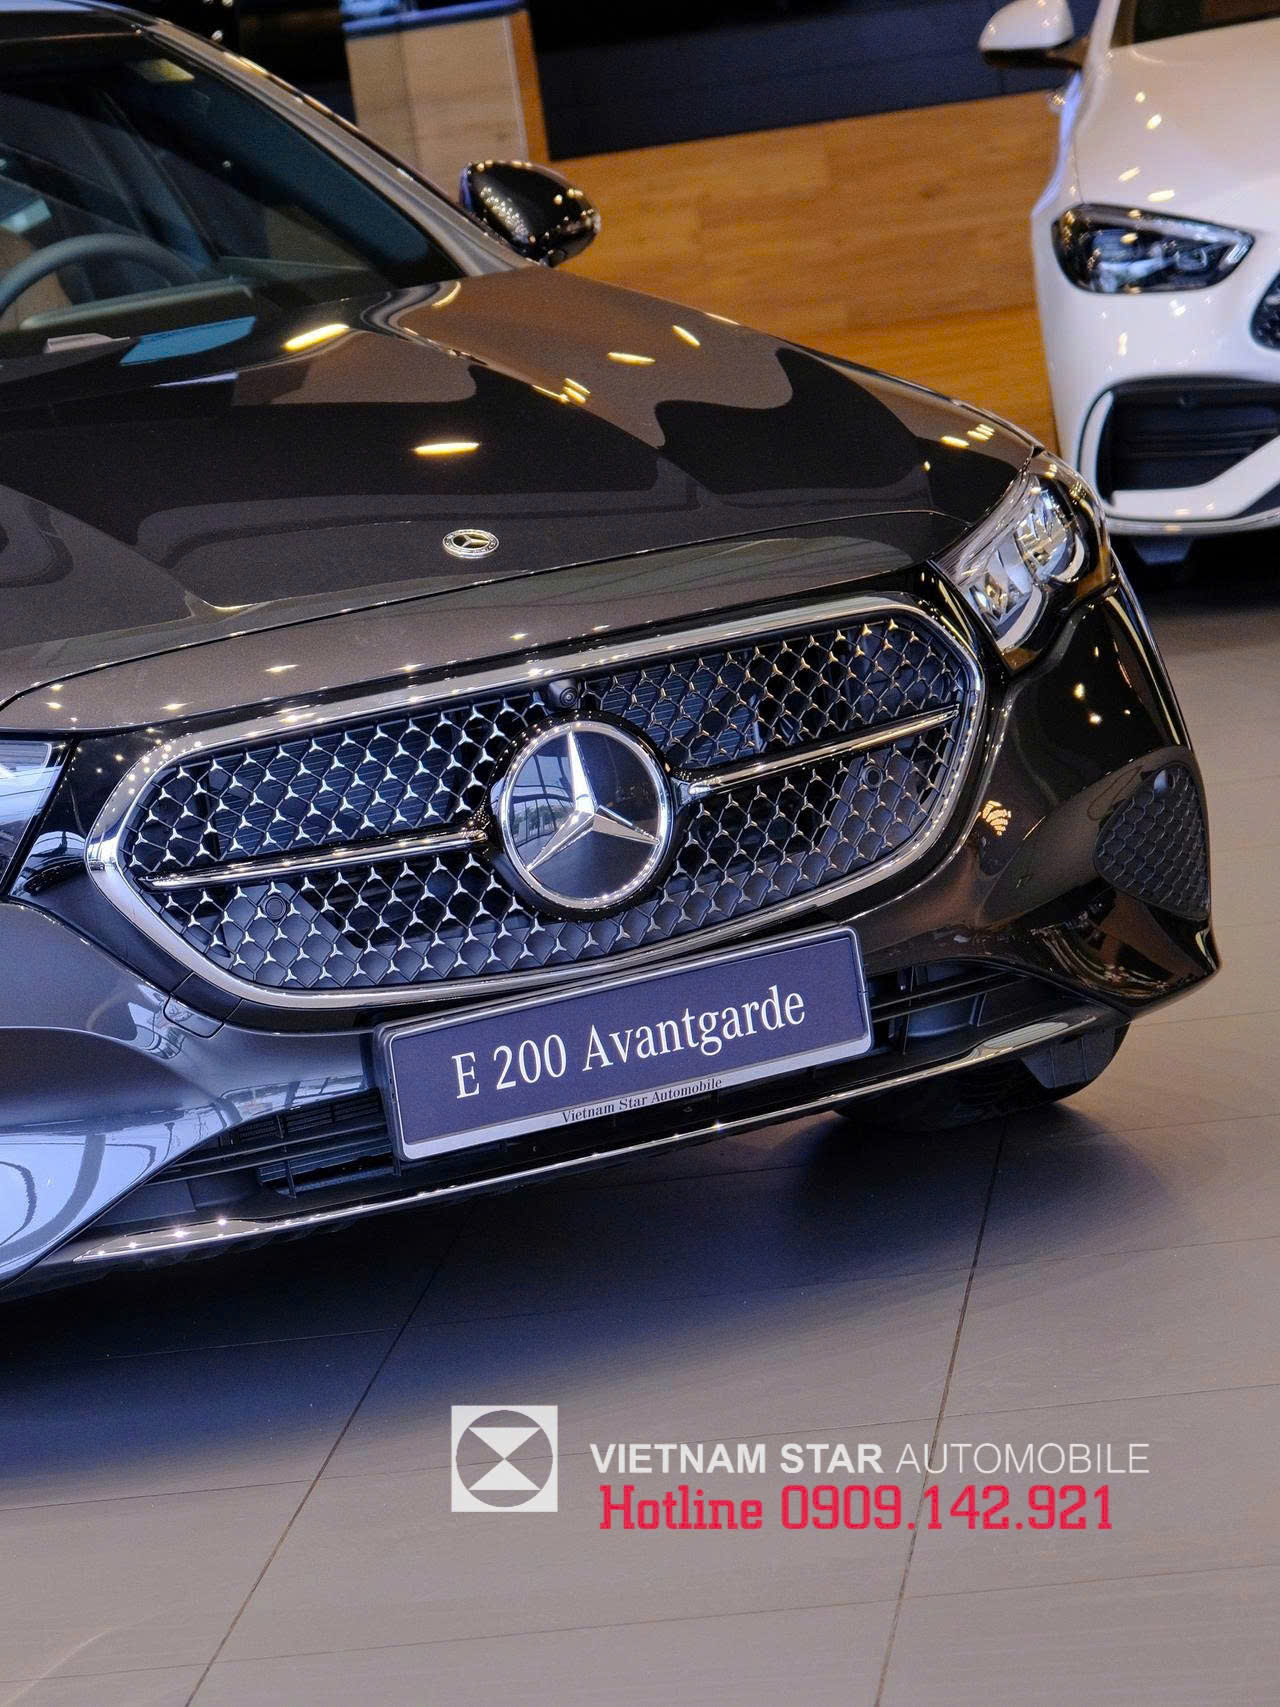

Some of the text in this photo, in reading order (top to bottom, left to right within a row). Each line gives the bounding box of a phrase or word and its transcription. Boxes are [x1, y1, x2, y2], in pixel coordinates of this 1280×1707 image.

[451, 984, 806, 1099] E 200 Avantgarde
[562, 1078, 722, 1124] Vietnam Star Automobile
